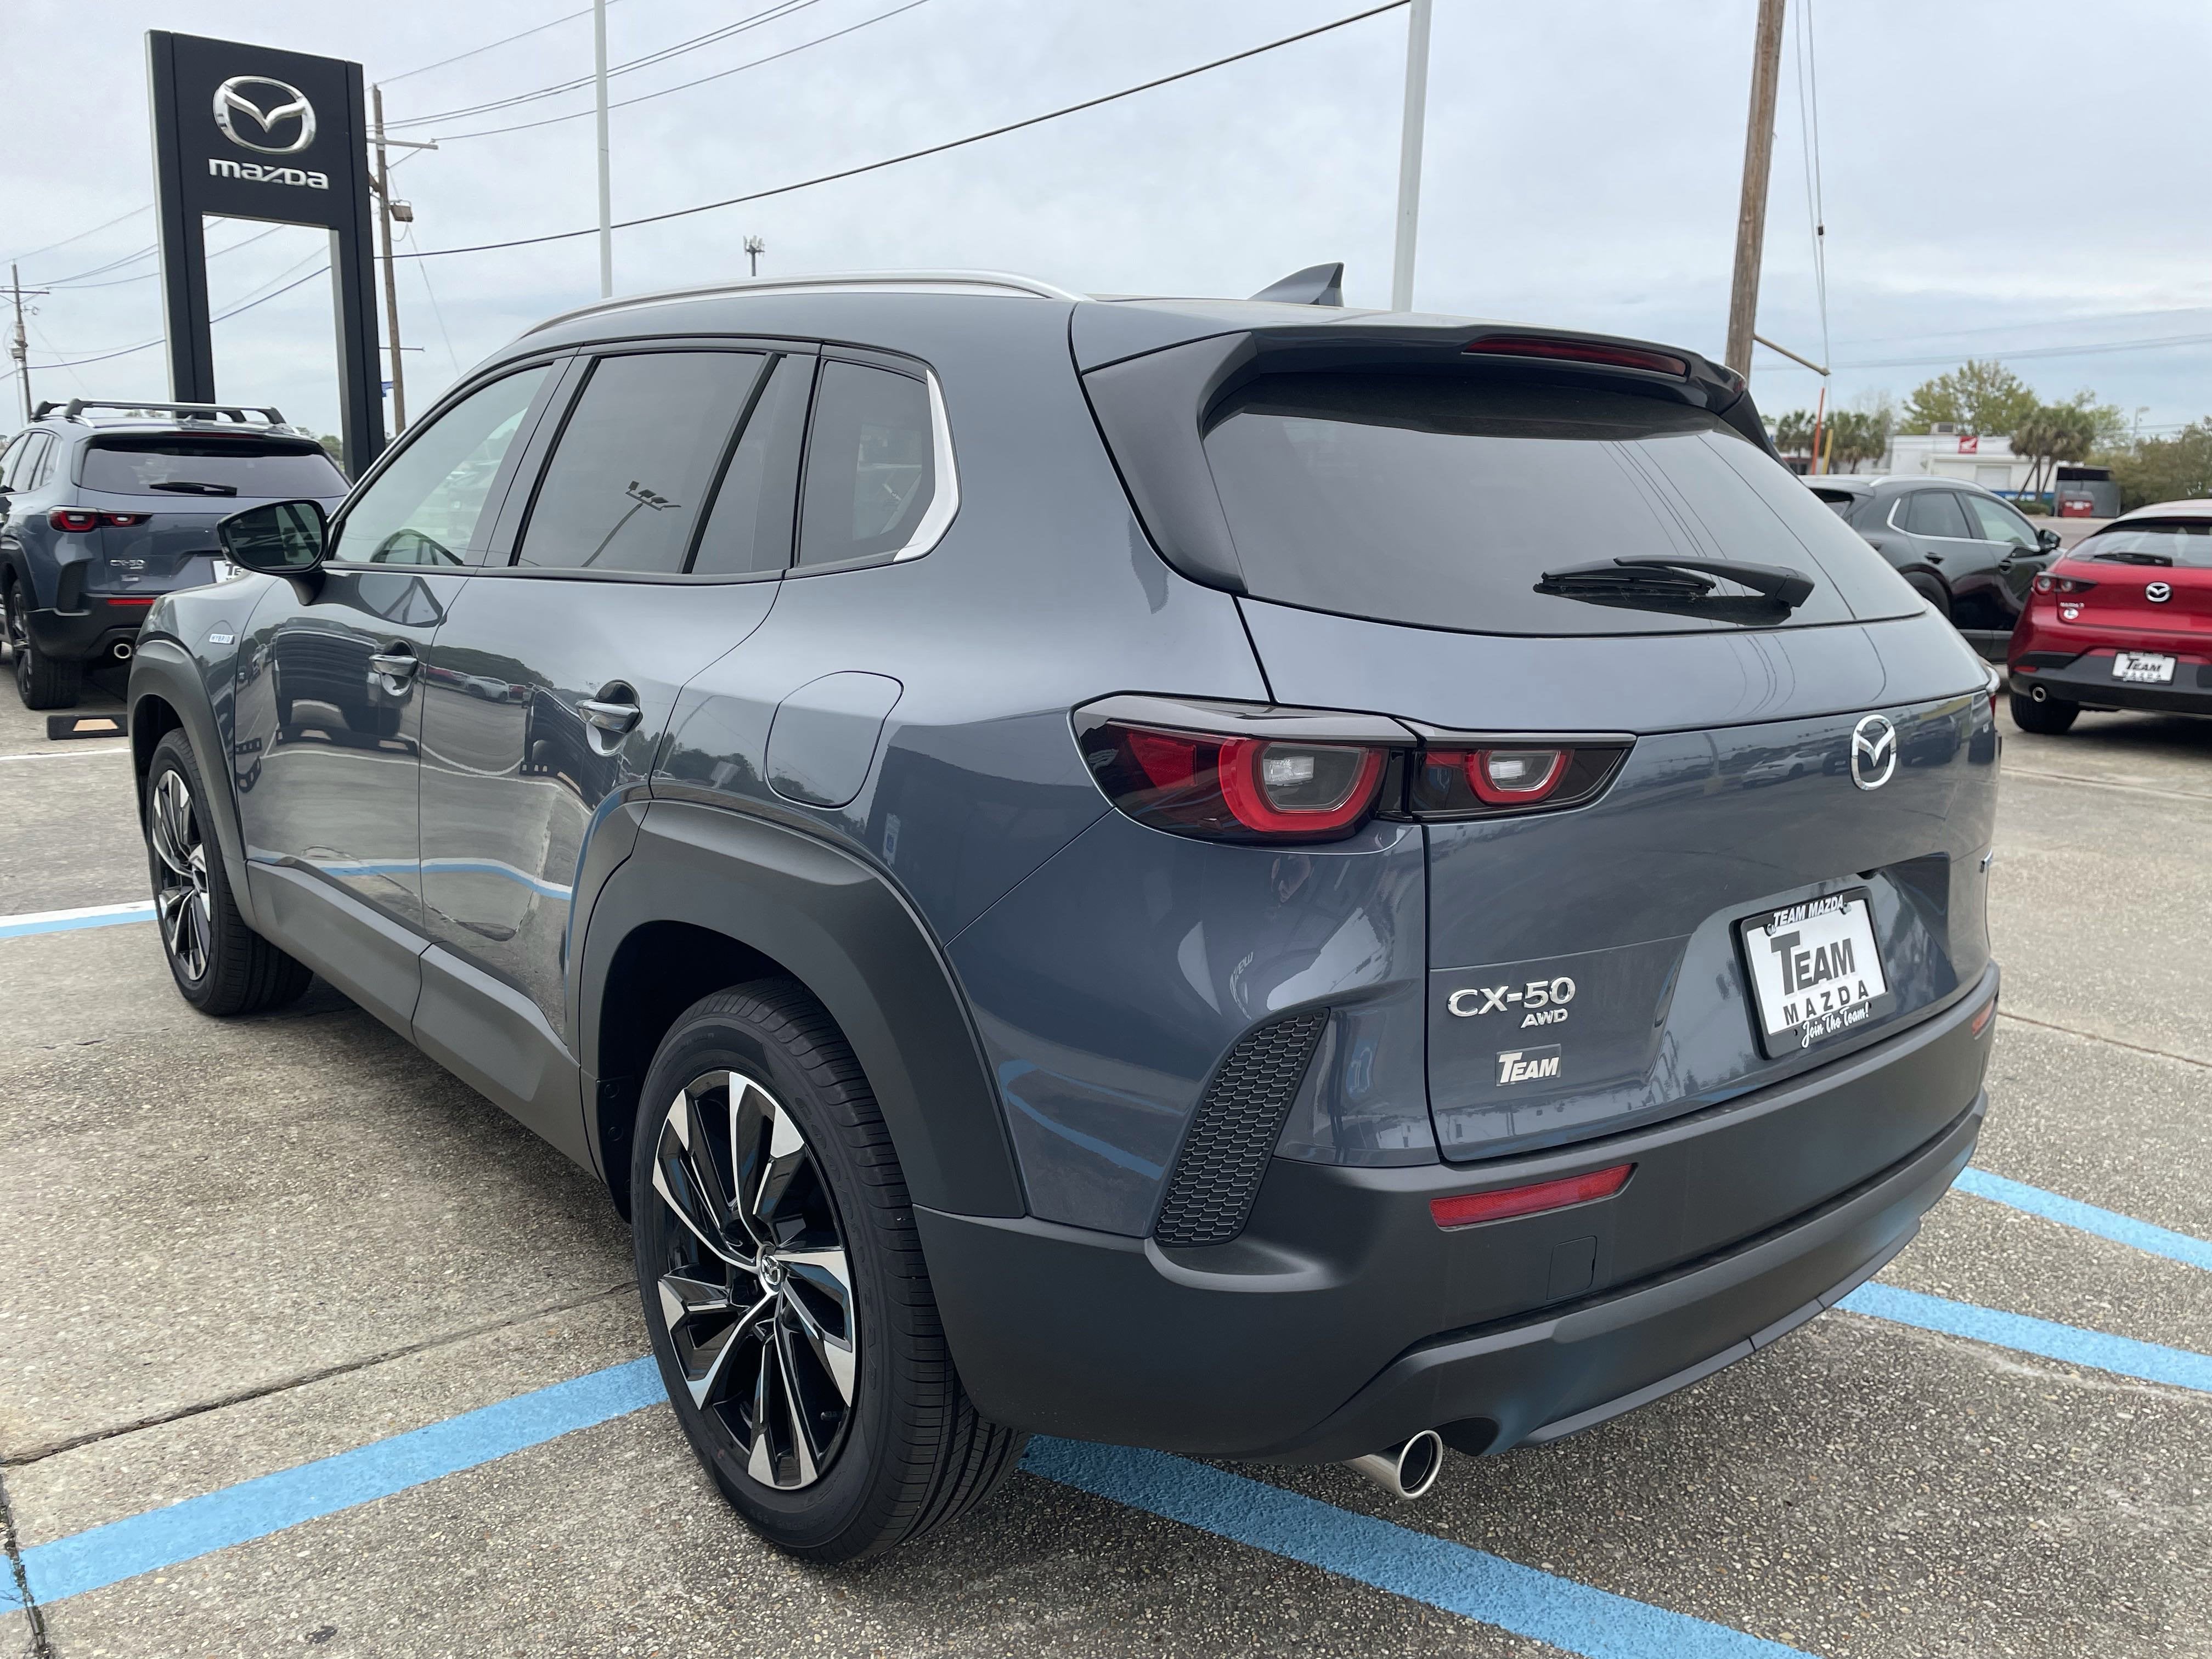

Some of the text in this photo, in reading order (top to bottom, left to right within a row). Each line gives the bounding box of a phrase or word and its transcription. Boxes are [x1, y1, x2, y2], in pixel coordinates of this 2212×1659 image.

[2126, 658, 2162, 672] TEAM
[1773, 895, 1844, 927] TEAM MAZDA
[1770, 930, 1856, 996] TEAM
[1448, 977, 1576, 1017] CX-50
[1783, 980, 1869, 1025] MAZDA
[1520, 1008, 1568, 1029] AWD
[1801, 1001, 1869, 1048] Join The Team!
[1498, 1052, 1560, 1084] TEAM
